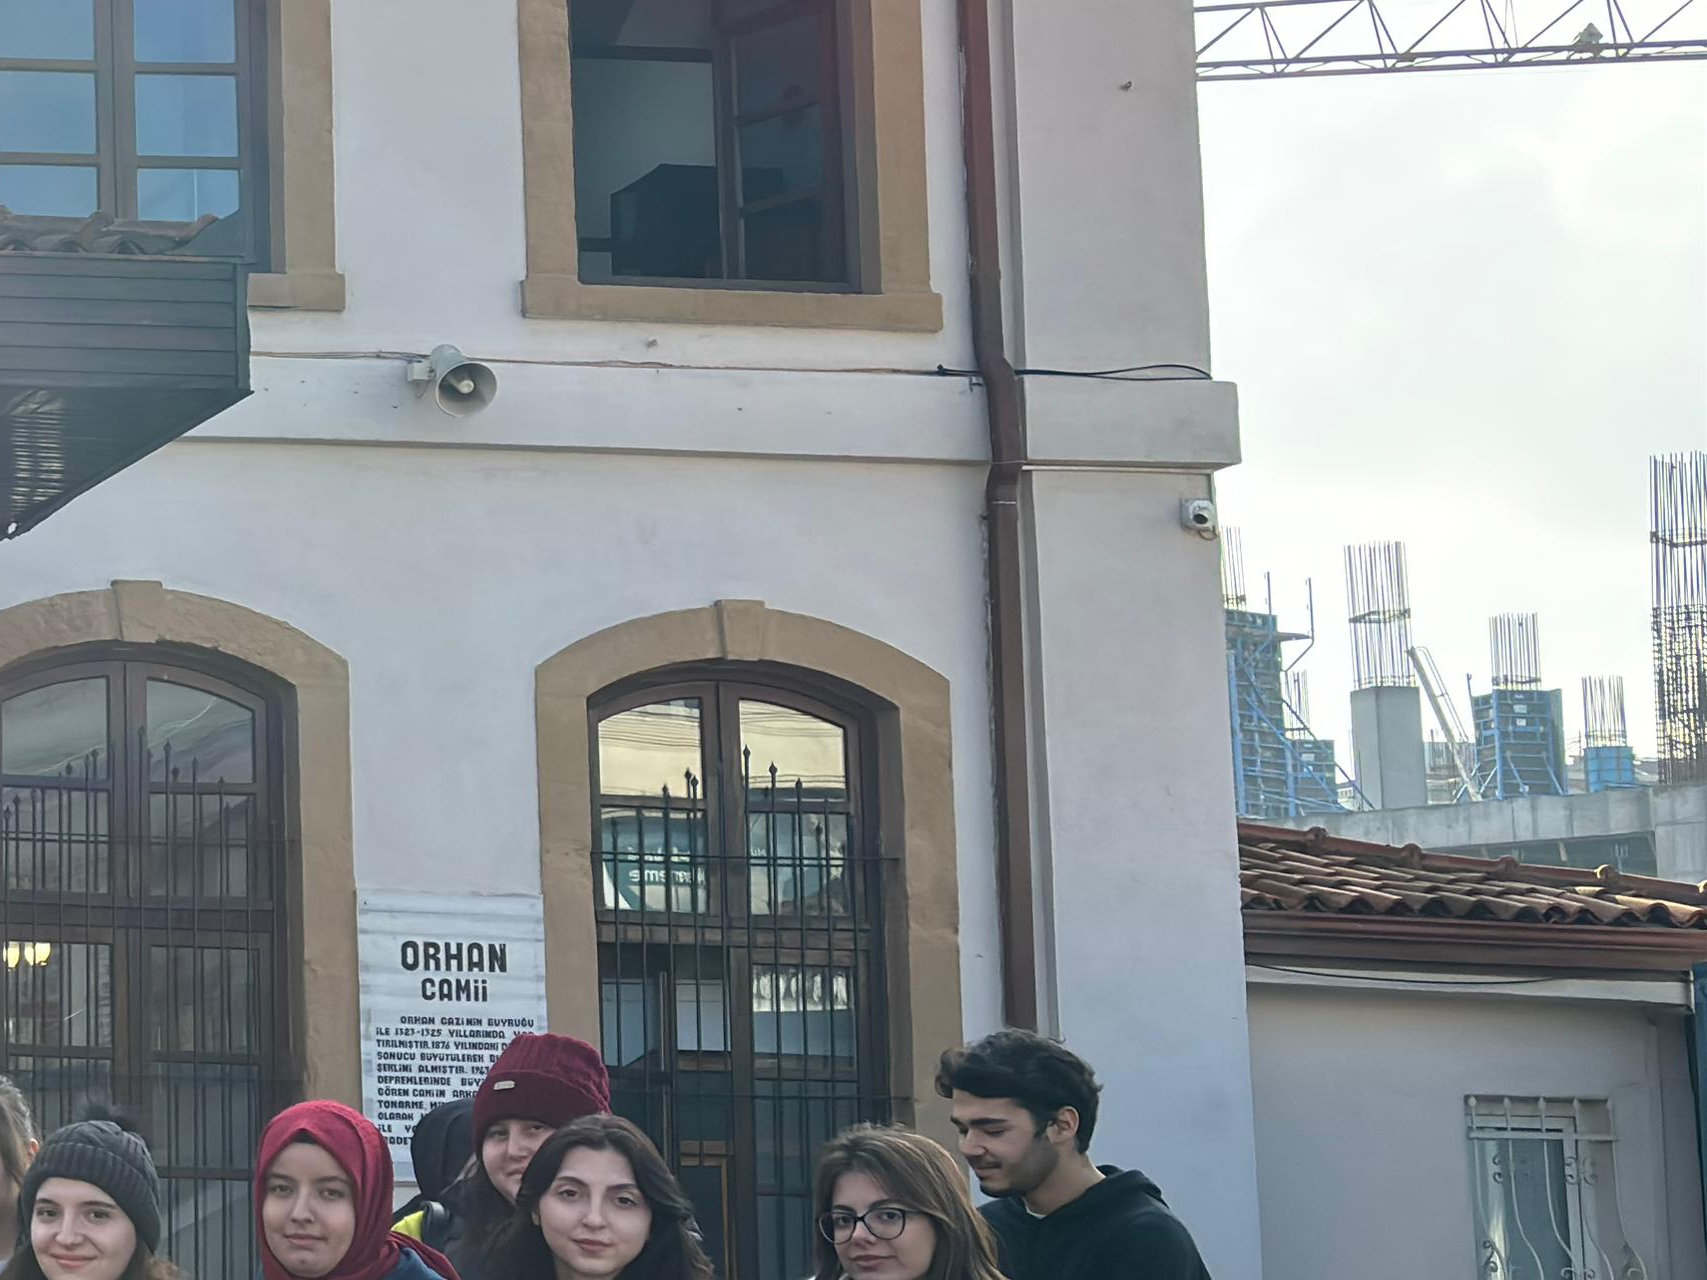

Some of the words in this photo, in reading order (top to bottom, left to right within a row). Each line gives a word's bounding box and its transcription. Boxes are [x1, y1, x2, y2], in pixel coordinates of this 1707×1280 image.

[400, 940, 507, 973] ORHAN
[400, 1016, 435, 1025] ORHAN
[377, 1051, 416, 1061] SONUCU
